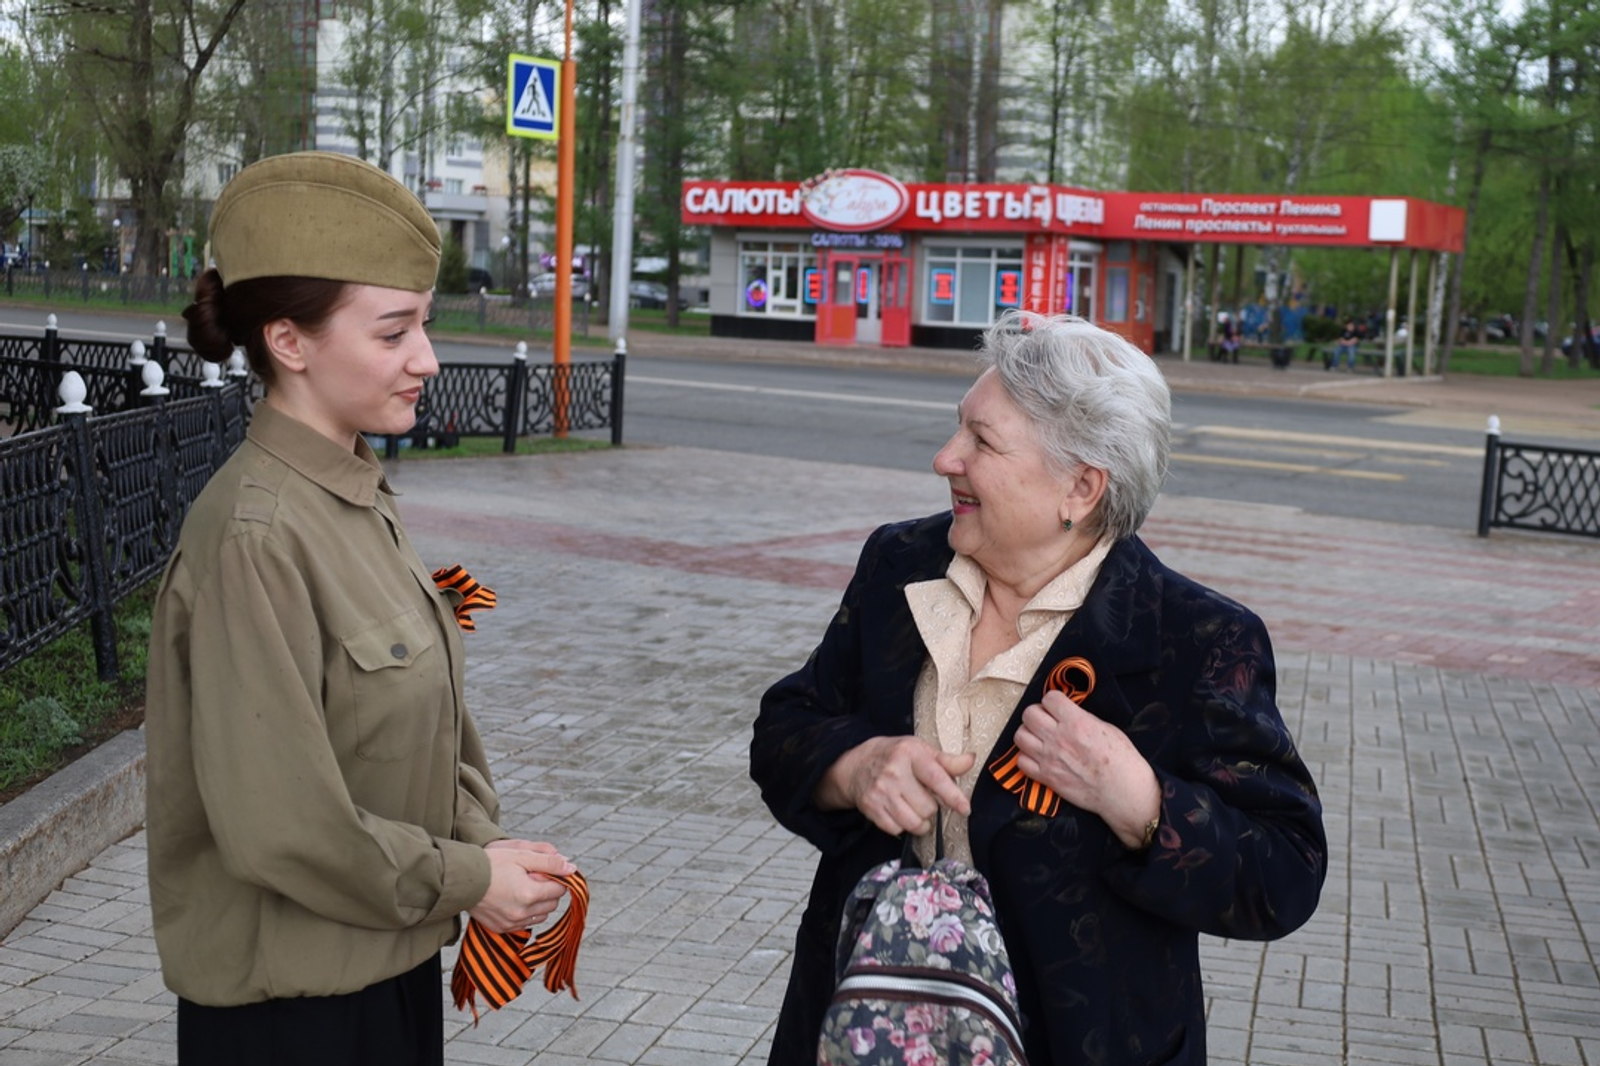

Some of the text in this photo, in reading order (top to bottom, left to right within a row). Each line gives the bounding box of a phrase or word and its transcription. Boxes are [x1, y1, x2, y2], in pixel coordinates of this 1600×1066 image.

[685, 187, 801, 214] САЛЮТЫ
[916, 191, 1032, 223] ЦВЕТЫ
[1140, 198, 1341, 216] остановка Проспект Ленина
[1134, 214, 1182, 230] Ленин
[1185, 219, 1272, 234] проспекты
